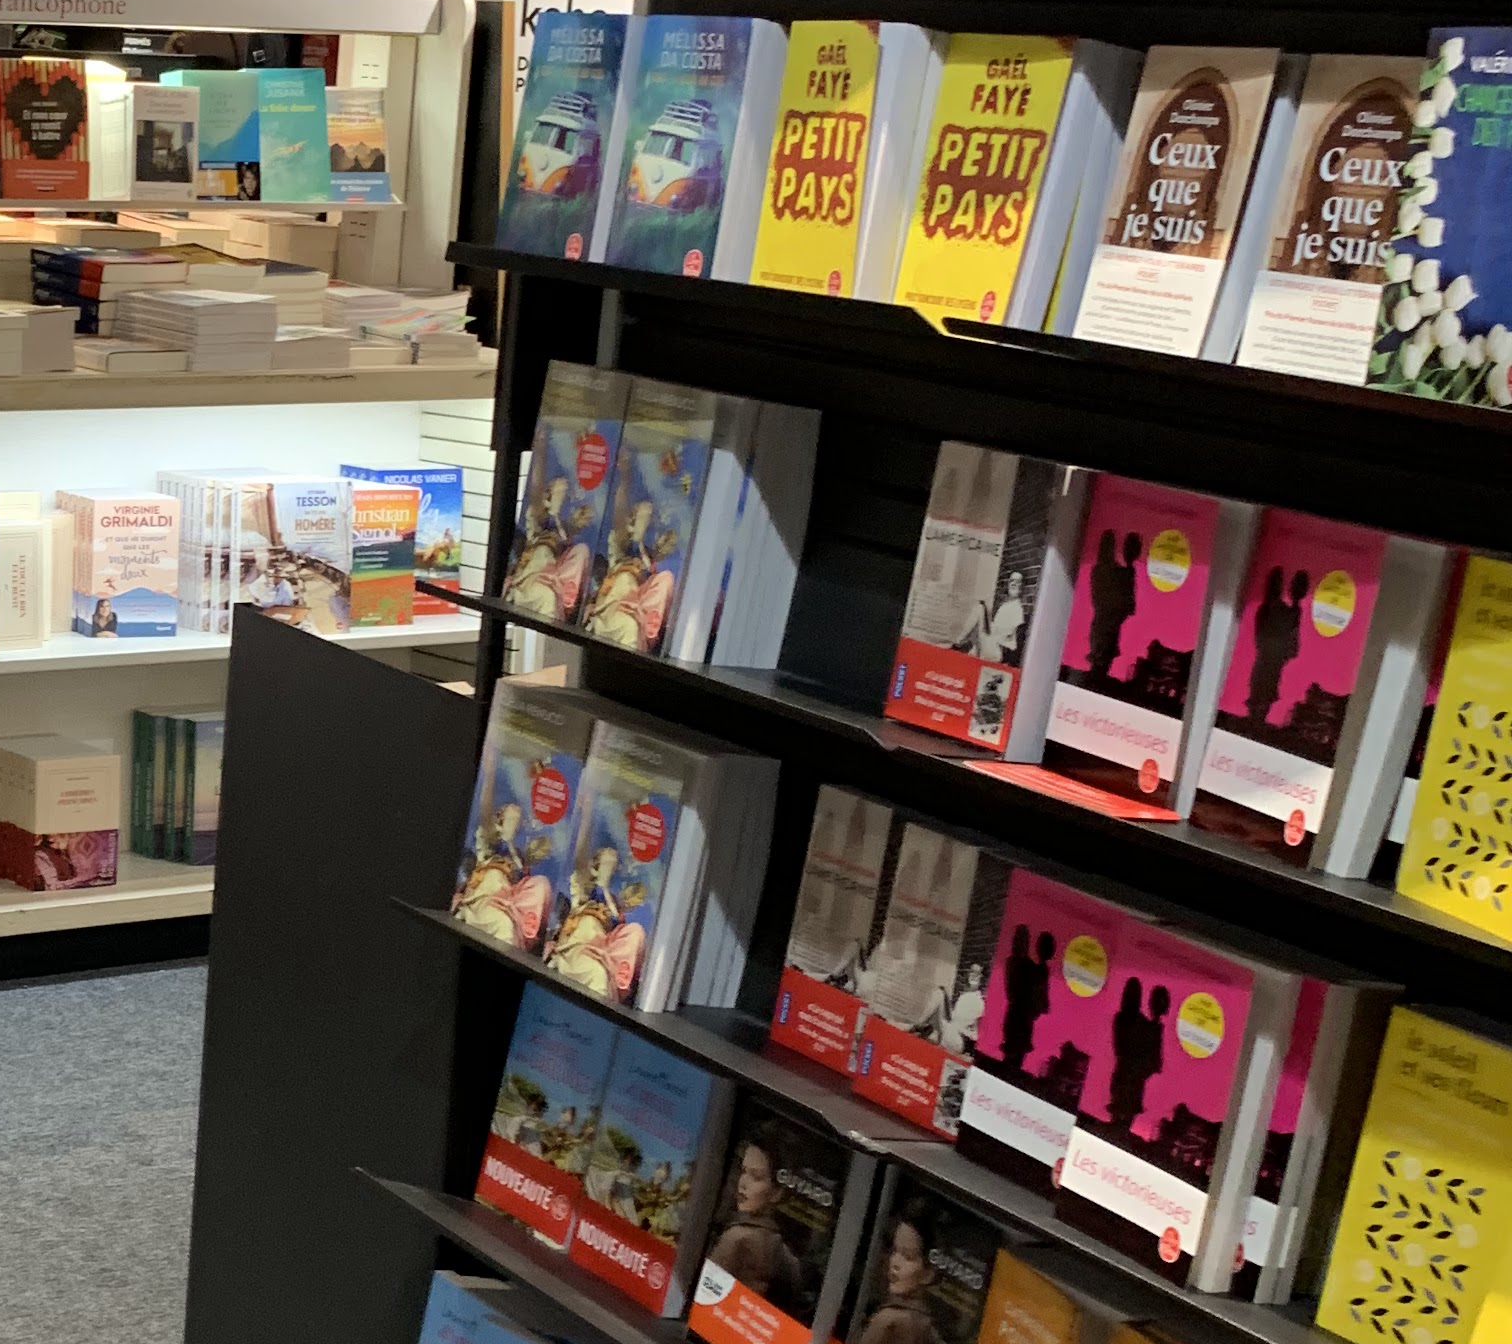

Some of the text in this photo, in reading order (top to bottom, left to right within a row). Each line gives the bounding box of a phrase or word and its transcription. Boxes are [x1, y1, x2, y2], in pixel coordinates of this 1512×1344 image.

[679, 51, 722, 70] COSTA
[817, 40, 847, 66] GAËL
[986, 53, 1028, 80] GAËL
[806, 68, 851, 101] FAYE
[971, 83, 1032, 117] FAYE
[783, 116, 862, 163] PETIT
[939, 132, 1042, 182] PETIT
[1148, 133, 1221, 170] Ceux
[1319, 147, 1407, 188] Ceux
[777, 167, 853, 218] PAYS
[1148, 177, 1202, 210] que
[928, 184, 1023, 241] PAYS
[1122, 204, 1207, 245] je suis
[1321, 195, 1384, 231] que
[1292, 223, 1392, 268] je suis
[384, 474, 458, 484] NICOLAS VANIER
[114, 506, 160, 515] VIRGINIE
[296, 496, 337, 507] TESSON
[352, 507, 410, 524] hristian
[100, 516, 173, 528] GRIMALDI
[295, 518, 335, 531] HOMÈRE
[1056, 701, 1169, 754] Les victorieuses
[1209, 751, 1317, 804] Les victorieuses
[996, 1104, 1067, 1147] victorieus
[485, 1159, 555, 1211] NOUVEAUTÉ
[1072, 1149, 1192, 1225] Les victorieuses
[577, 1221, 648, 1279] NOUVEAUTÉ
